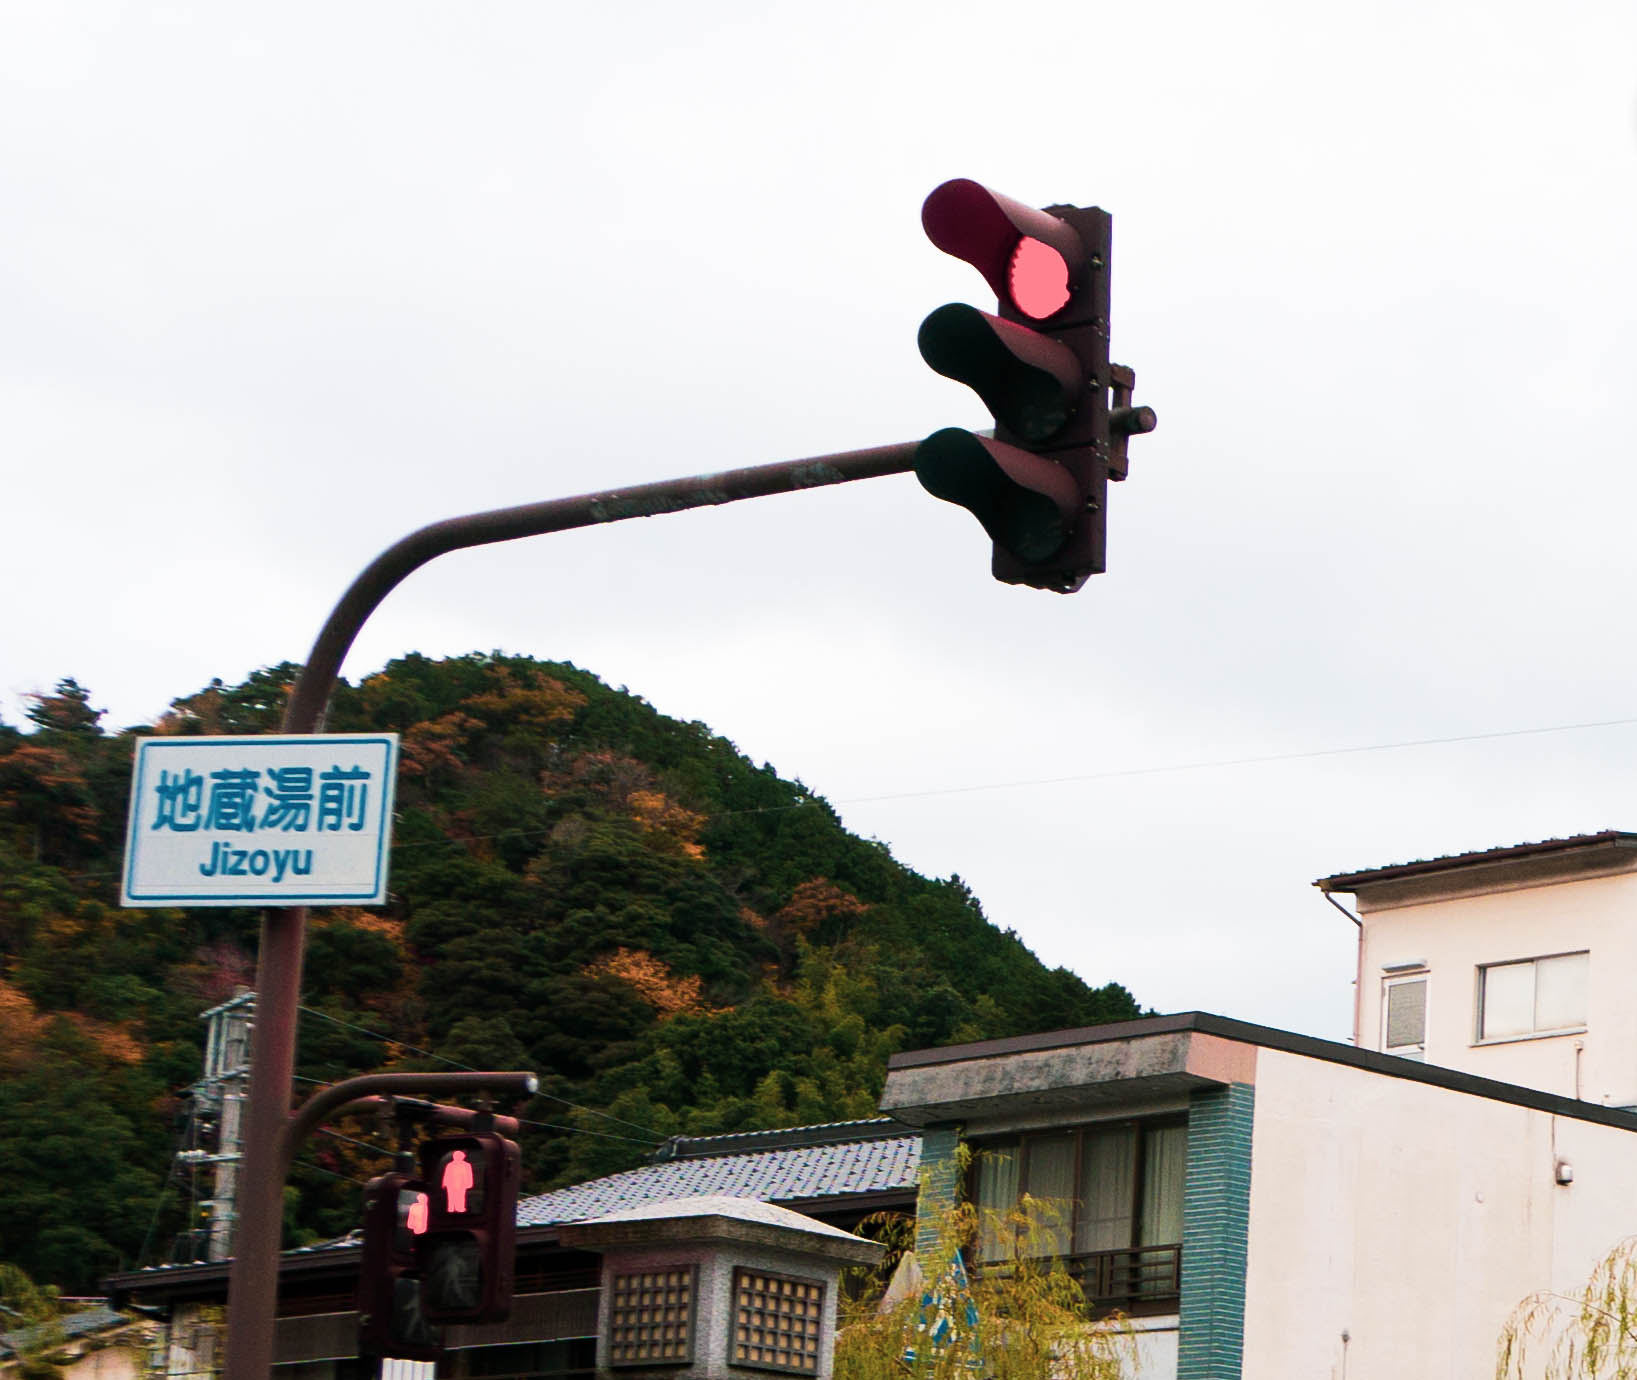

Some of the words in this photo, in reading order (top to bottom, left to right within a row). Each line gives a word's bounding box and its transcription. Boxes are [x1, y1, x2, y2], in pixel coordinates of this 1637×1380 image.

[150, 764, 372, 833] 地蔵湯前
[199, 840, 313, 883] Jizoyu
